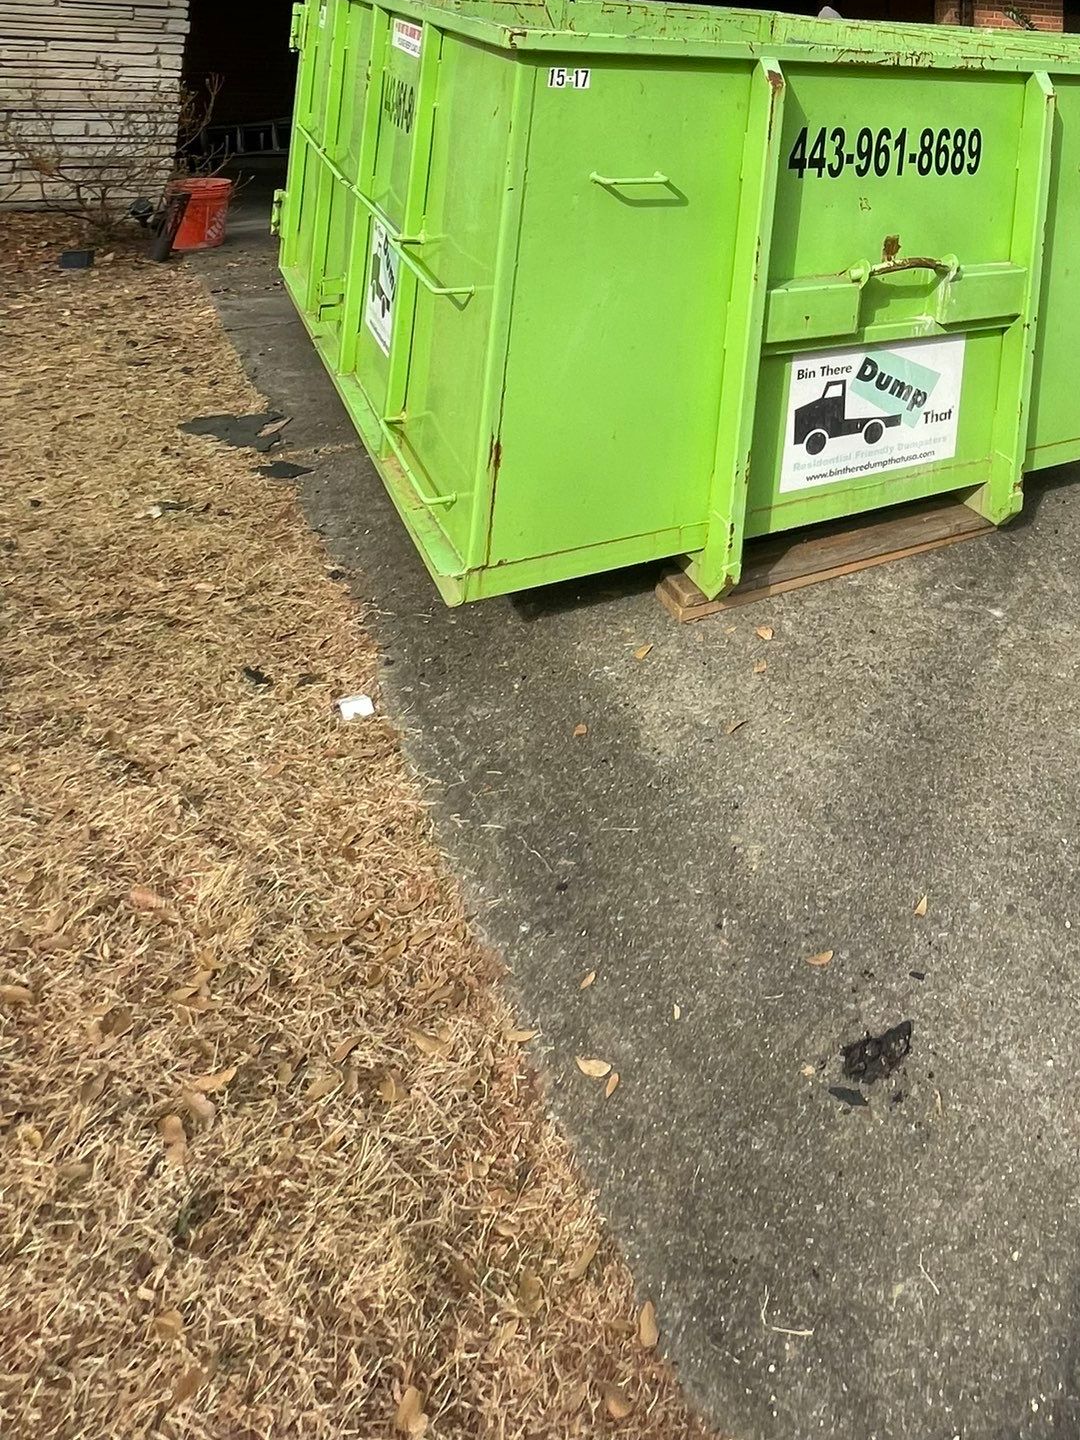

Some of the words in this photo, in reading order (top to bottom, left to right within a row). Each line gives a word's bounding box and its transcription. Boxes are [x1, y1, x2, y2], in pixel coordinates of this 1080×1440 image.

[549, 68, 589, 87] 15-17
[788, 126, 982, 179] 443-961-8689
[796, 368, 816, 381] Bin
[820, 364, 853, 378] There
[856, 356, 928, 412] Dump
[923, 408, 953, 425] That
[855, 444, 894, 459] Friendly
